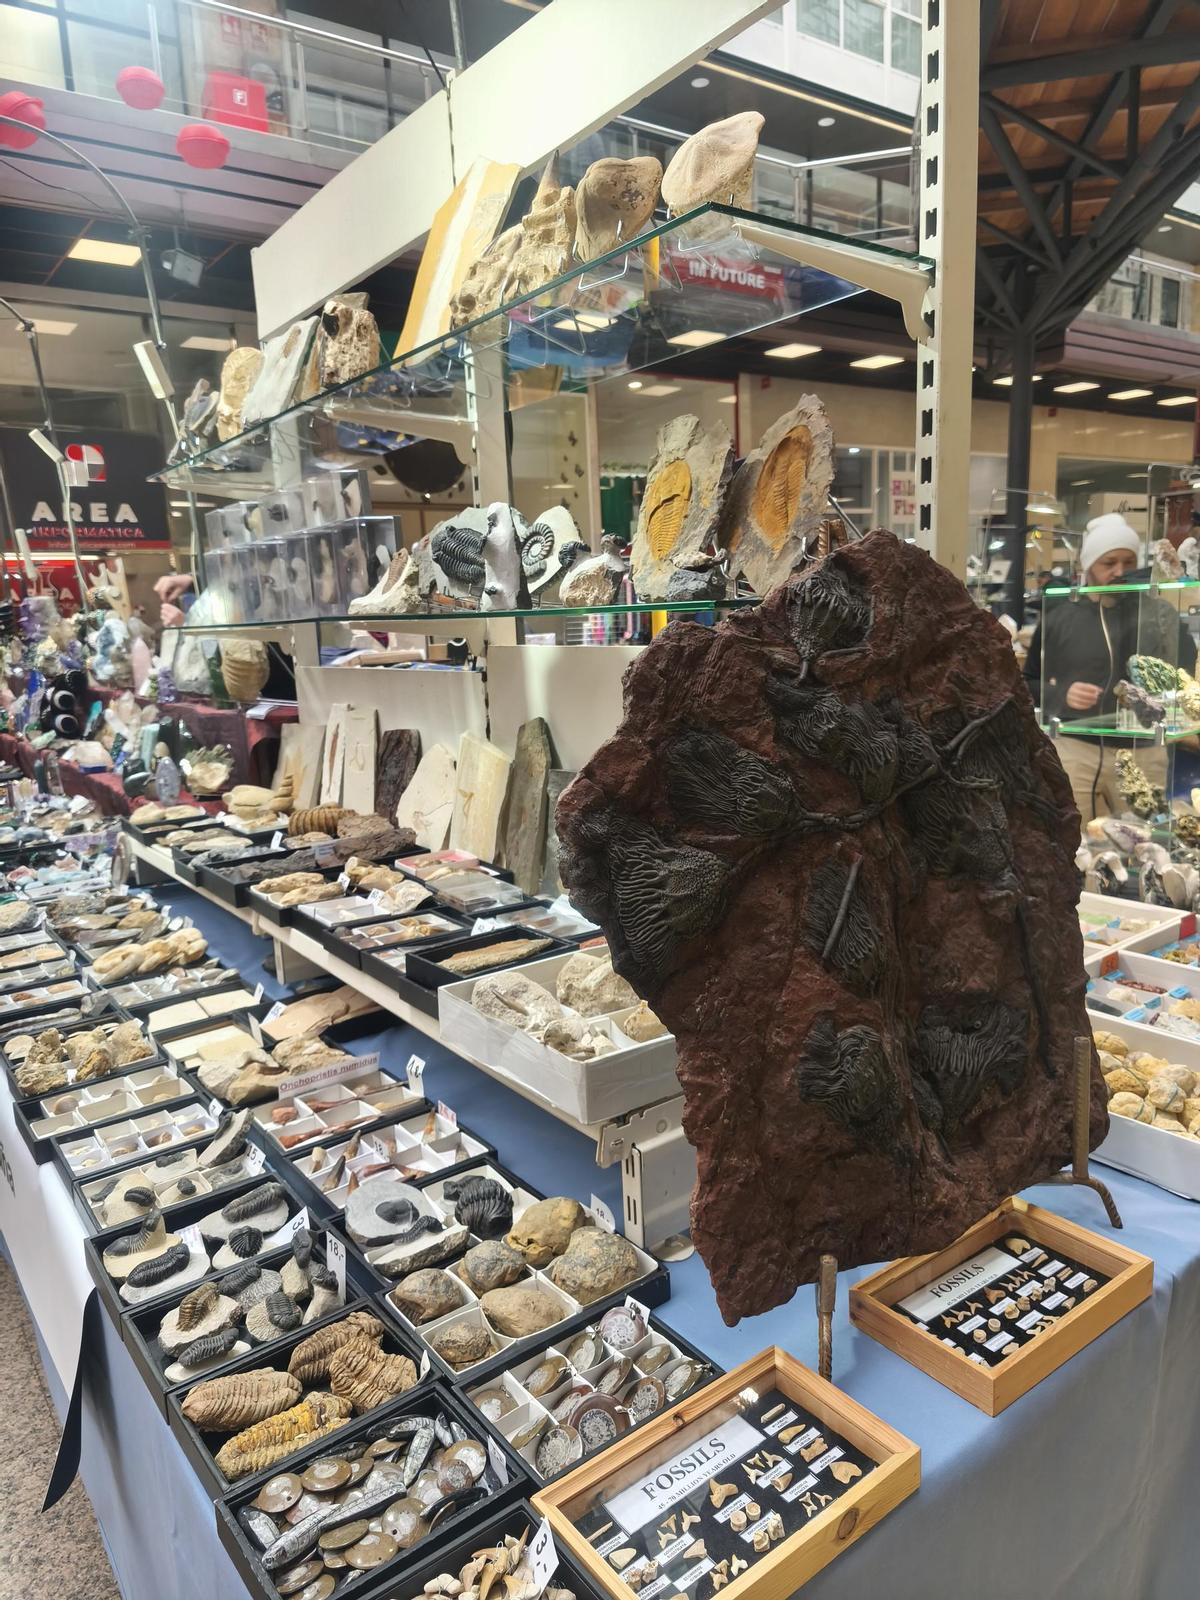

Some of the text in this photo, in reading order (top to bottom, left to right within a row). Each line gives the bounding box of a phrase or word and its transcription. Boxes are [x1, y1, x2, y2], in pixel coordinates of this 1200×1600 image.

[710, 265, 766, 289] FUTURE
[31, 501, 138, 523] AREA
[280, 1057, 378, 1091] Onchopristis numidus
[328, 1239, 344, 1261] 18,-
[929, 1262, 985, 1299] FOSSILS
[640, 1437, 726, 1501] FOSSILS
[657, 1501, 666, 1510] 45
[668, 1494, 677, 1503] 70
[675, 1475, 703, 1497] MILLION
[702, 1460, 723, 1478] YEARS
[721, 1452, 736, 1465] OLD
